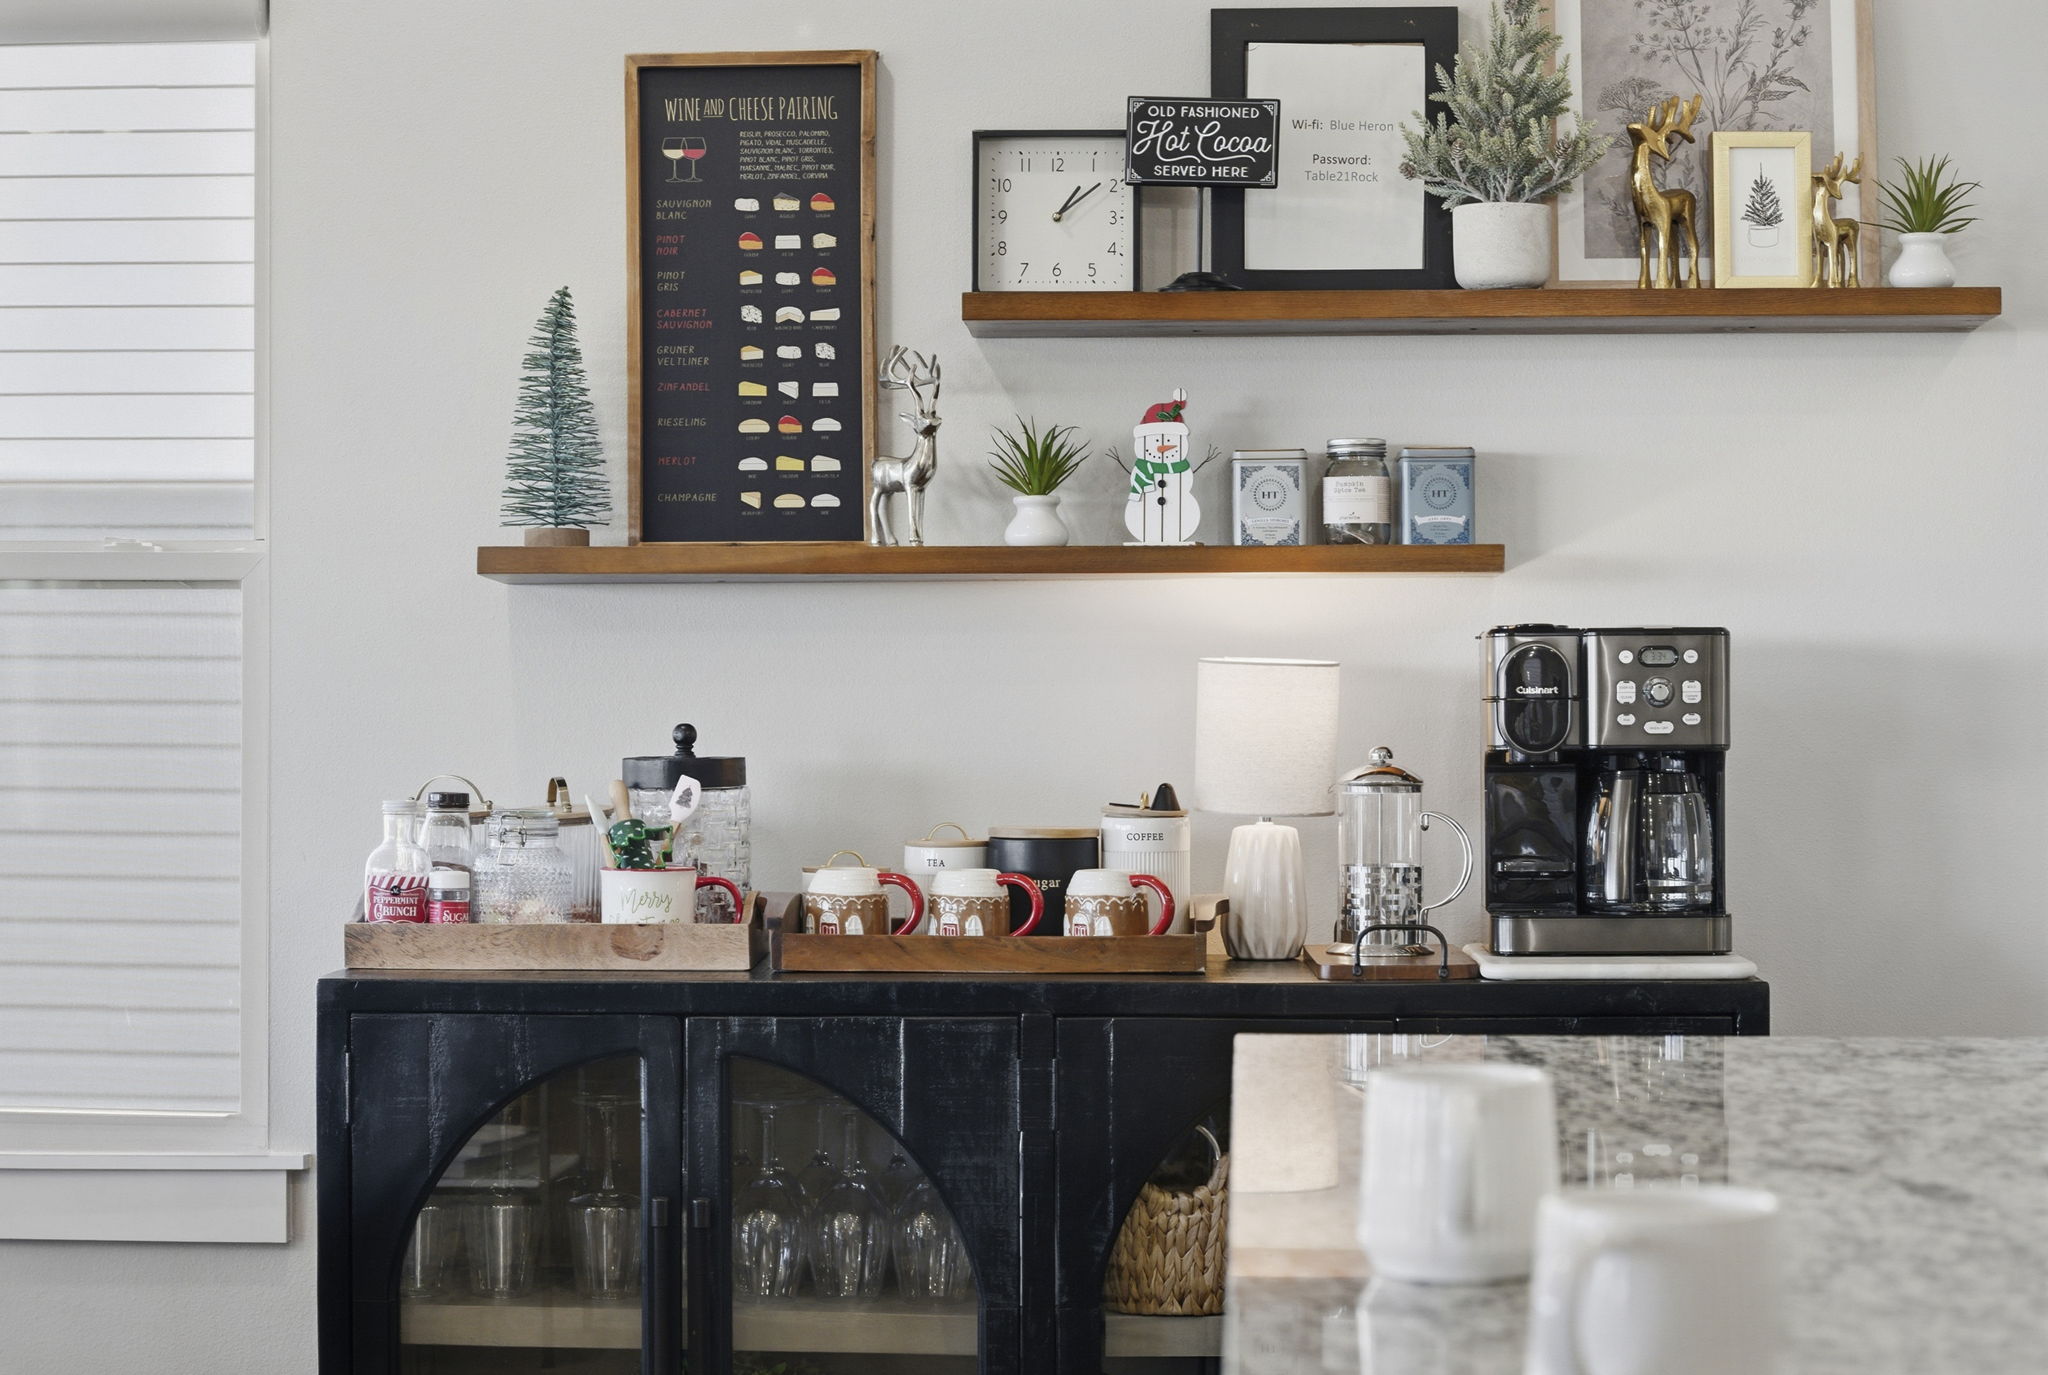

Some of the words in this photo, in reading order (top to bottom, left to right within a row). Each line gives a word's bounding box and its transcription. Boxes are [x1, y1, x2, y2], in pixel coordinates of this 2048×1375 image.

[664, 98, 701, 122] WINE
[703, 98, 725, 118] AND
[729, 97, 775, 121] CHEESE
[779, 95, 838, 121] PAIRING
[1148, 105, 1176, 118] OLD
[1181, 106, 1260, 119] FASHIONED
[1292, 119, 1323, 130] Wi-fi:
[1330, 120, 1355, 131] Blue
[1358, 120, 1394, 132] Heron
[1133, 120, 1201, 163] Hot
[1194, 121, 1272, 163] Cocoa
[1020, 158, 1031, 172] 11
[1051, 158, 1065, 172] 12
[1312, 154, 1372, 166] Password:
[1153, 164, 1207, 177] SERVED
[1212, 165, 1249, 178] HERE
[1304, 170, 1378, 182] Table21Rock
[997, 179, 1012, 193] 10
[1109, 178, 1118, 193] 2
[656, 199, 712, 209] SAUVIGNON
[656, 211, 688, 220] BLANC
[998, 210, 1008, 225] 9
[1109, 210, 1118, 225] 3
[656, 234, 686, 244] PINOT
[656, 247, 679, 256] NOIR
[997, 241, 1008, 256] 8
[1107, 241, 1117, 256] 4
[1020, 262, 1029, 277] 7
[1052, 262, 1062, 277] 6
[1088, 262, 1097, 276] 5
[657, 271, 686, 280] PINOT
[657, 283, 679, 292] GRIS
[656, 308, 707, 318] CABERNET
[656, 320, 713, 329] SAUVIGNON
[656, 345, 695, 355] GRUNER
[657, 357, 710, 366] VELTLINER
[657, 382, 710, 392] ZINFANDEL
[657, 417, 707, 427] RIESELING
[658, 456, 697, 466] MERLOT
[657, 493, 718, 502] CHAMPAGNE
[1262, 491, 1280, 499] HT
[1431, 489, 1450, 498] HT
[1515, 685, 1559, 695] Cuisinart
[1127, 832, 1164, 842] COFFEE
[926, 858, 945, 868] TEA
[1033, 879, 1061, 891] ugar
[373, 896, 418, 905] PEPPERMINT
[621, 889, 673, 914] Merry
[373, 903, 417, 920] CRUNCH
